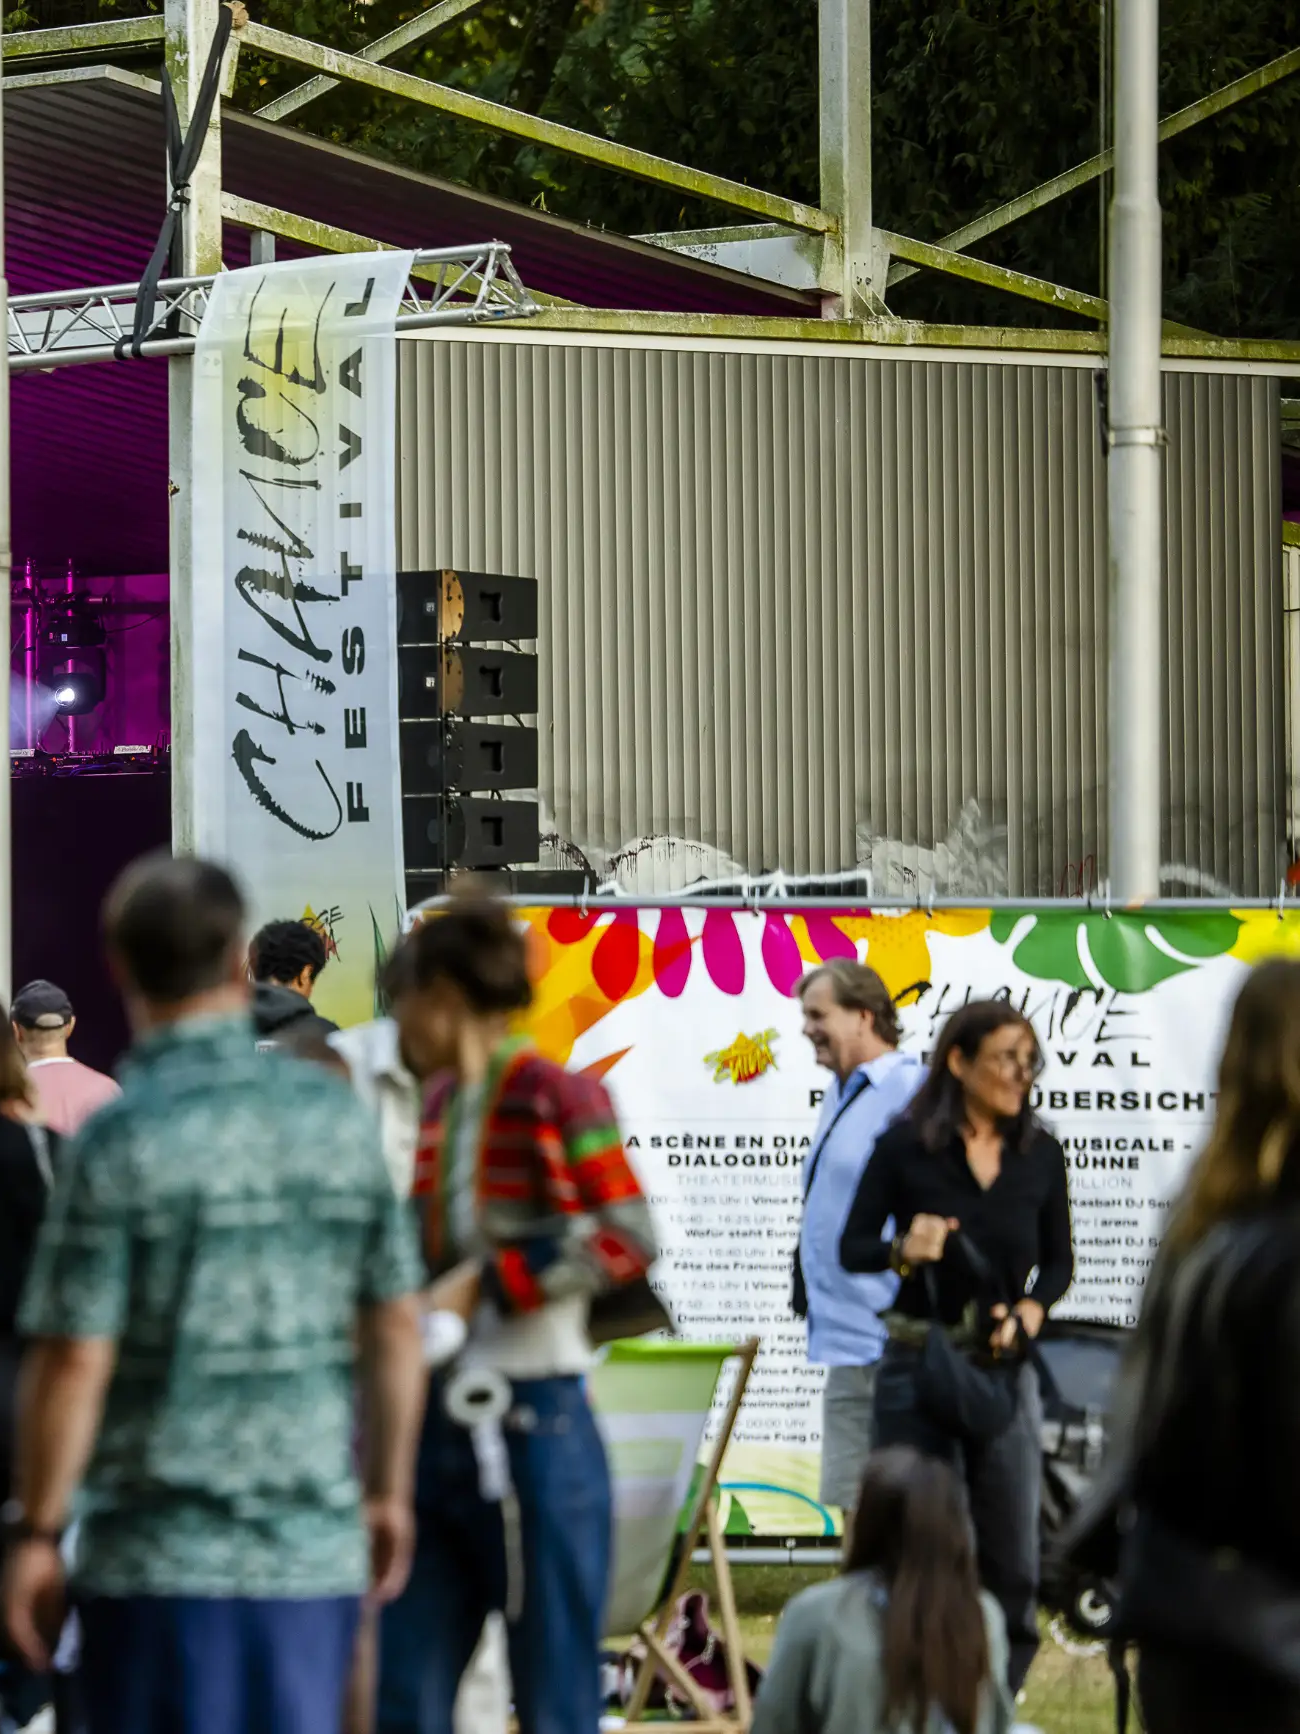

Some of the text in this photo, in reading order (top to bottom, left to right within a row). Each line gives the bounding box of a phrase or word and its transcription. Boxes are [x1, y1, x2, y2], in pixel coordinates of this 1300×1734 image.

[231, 274, 343, 842] CHANCE
[338, 277, 376, 823] FESTIVAL
[650, 1133, 725, 1149] SCÈNE
[735, 1133, 763, 1149] EN
[895, 981, 1152, 1044] CHNCE
